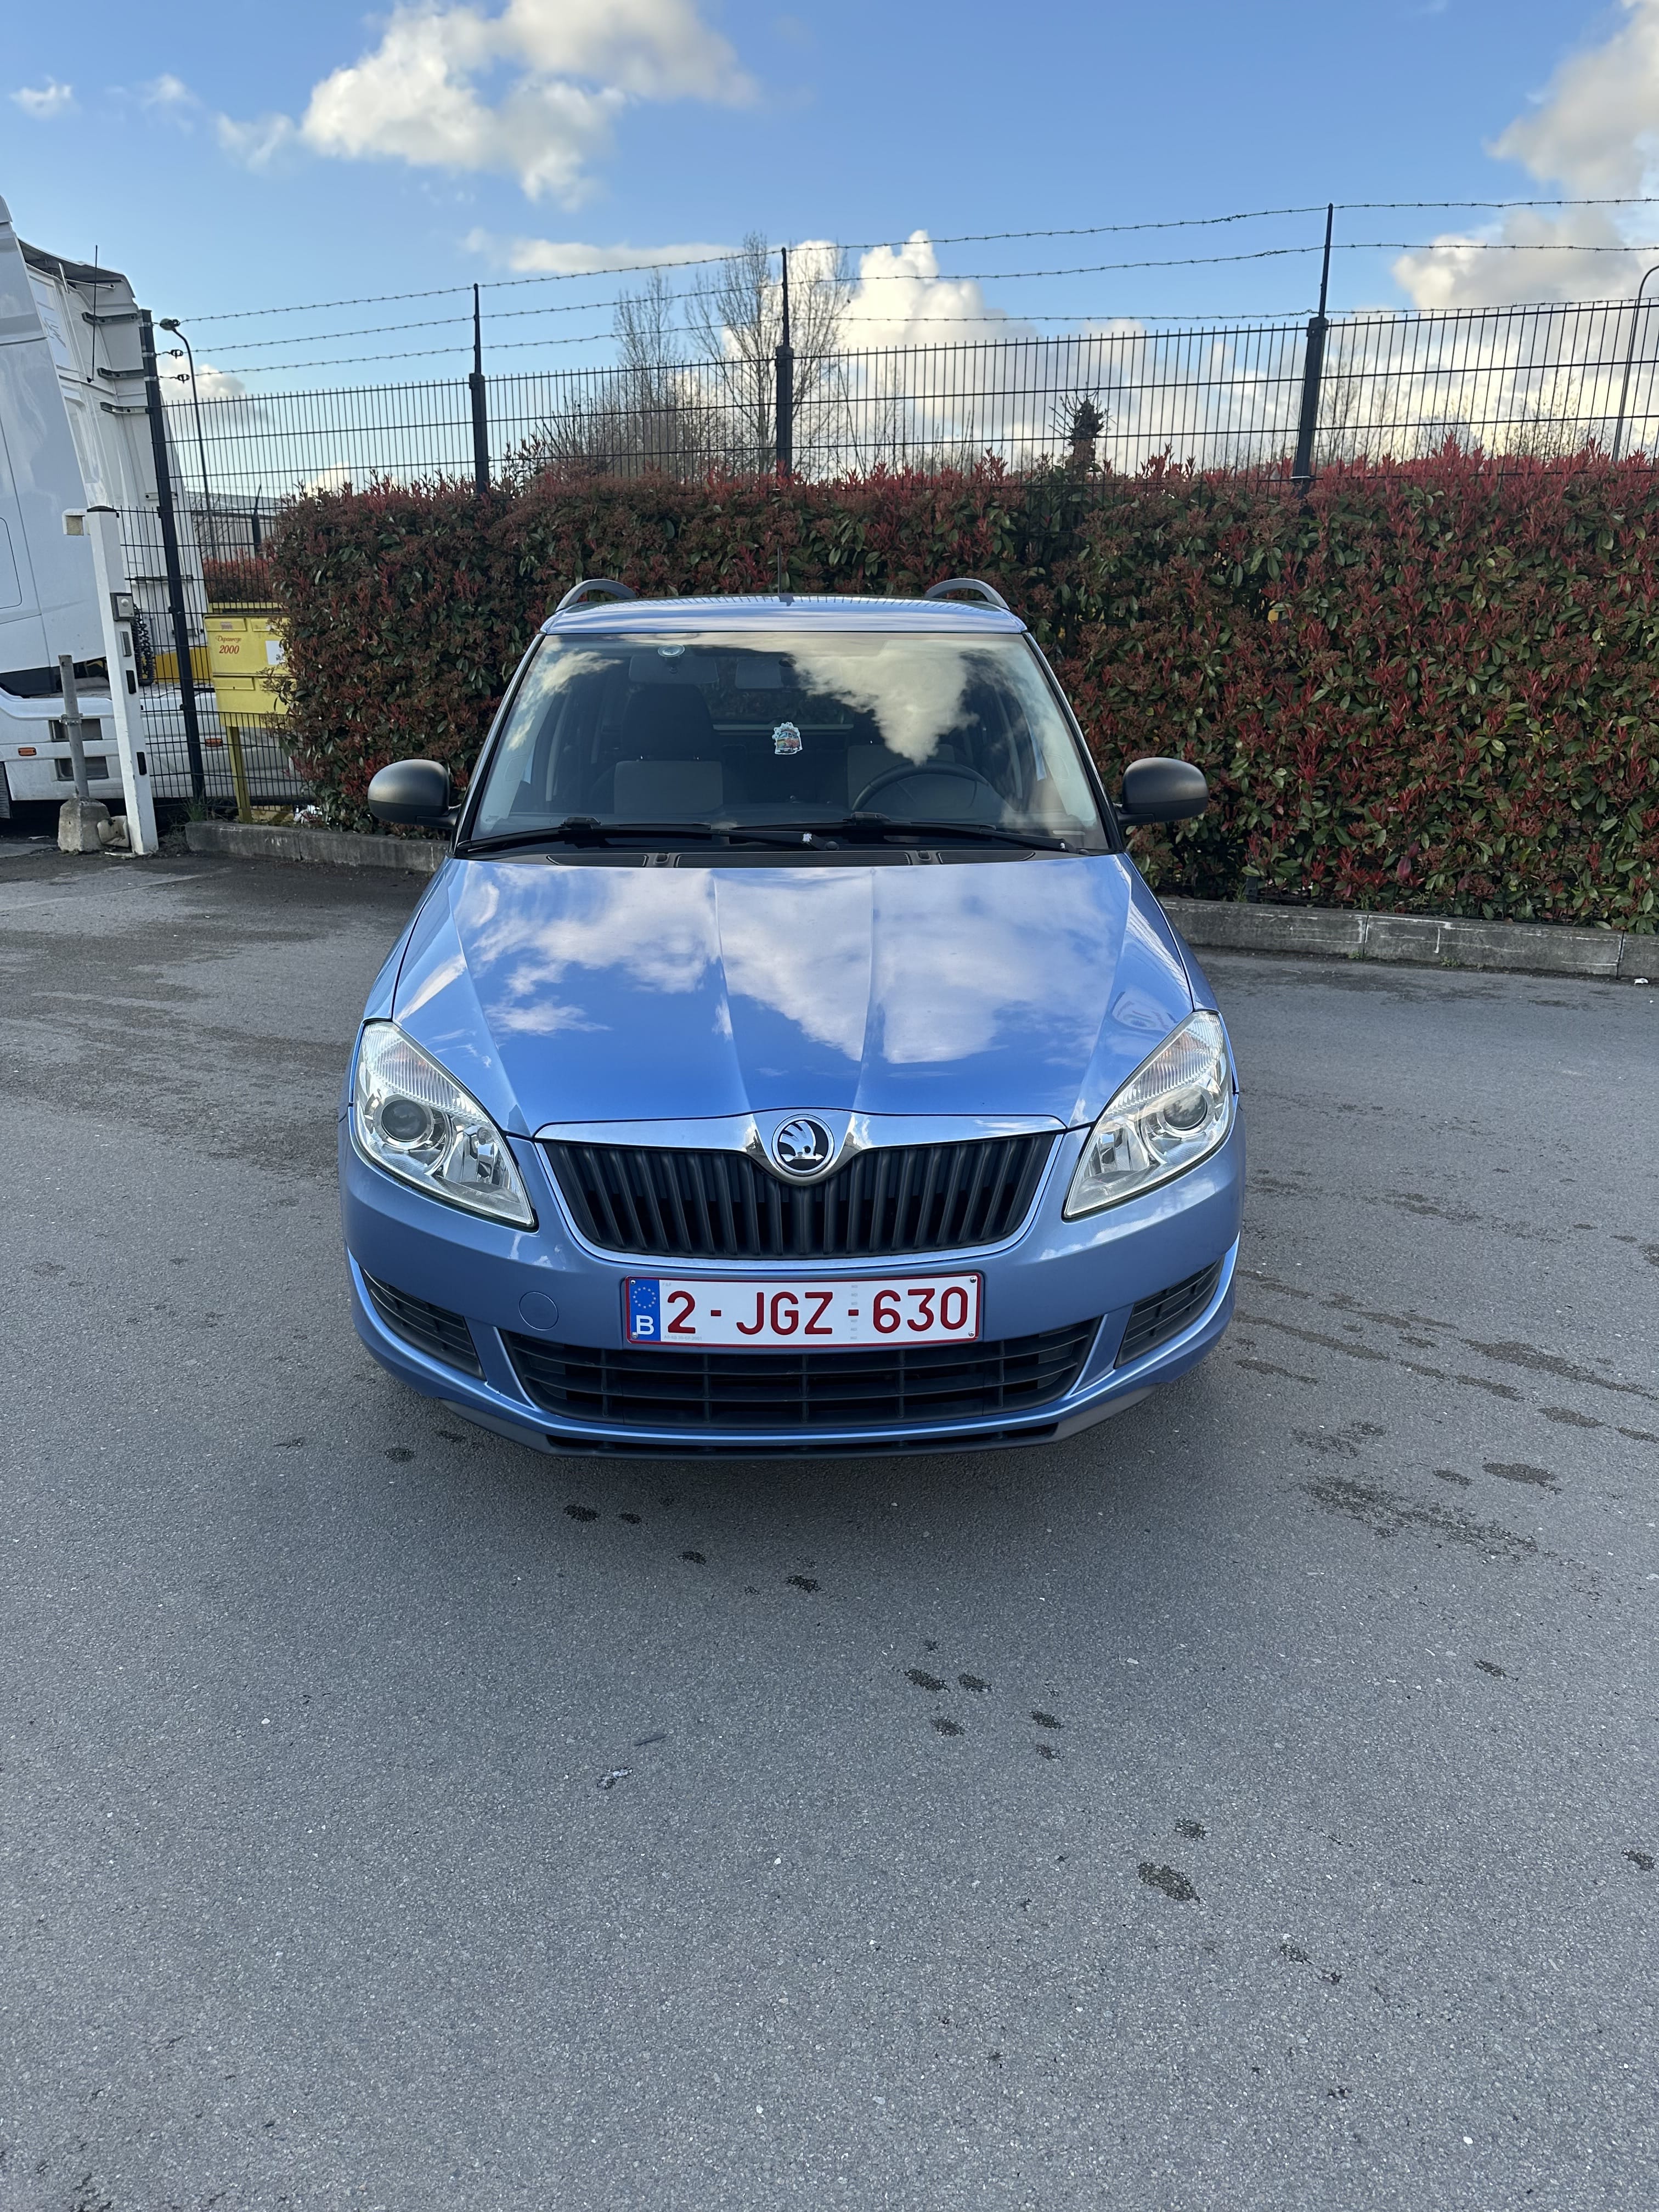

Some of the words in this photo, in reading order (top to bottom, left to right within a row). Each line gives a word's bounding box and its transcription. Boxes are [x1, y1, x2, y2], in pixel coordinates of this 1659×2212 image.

[219, 645, 240, 654] 2000
[667, 1286, 968, 1335] 2-JGZ-630
[636, 1314, 654, 1335] B
